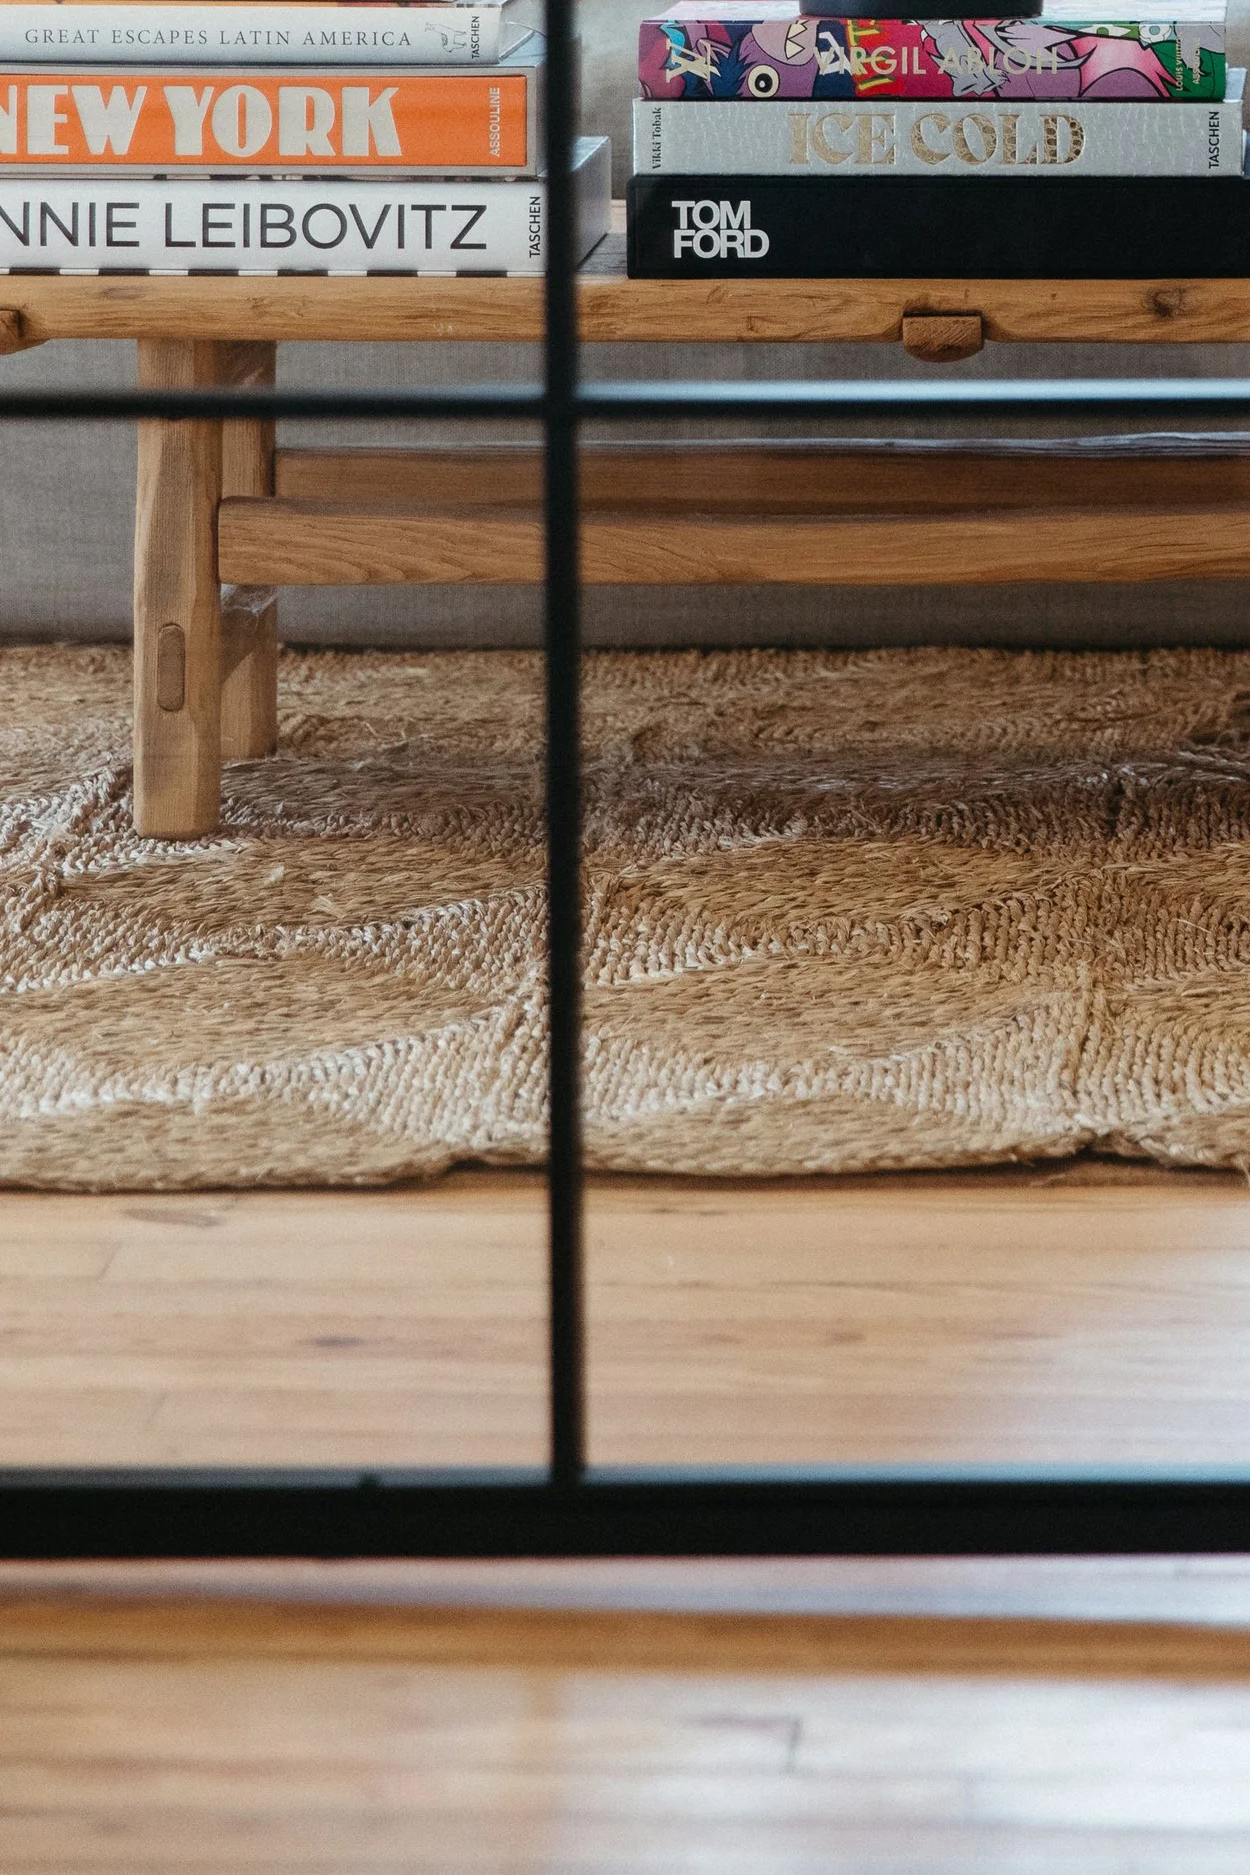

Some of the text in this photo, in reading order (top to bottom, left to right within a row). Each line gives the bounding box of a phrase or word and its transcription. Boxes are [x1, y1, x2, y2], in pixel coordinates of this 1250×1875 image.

[25, 29, 412, 46] GREAT ESCAPES LATIN AMERICA
[471, 15, 480, 59] TASCHEN
[813, 45, 1058, 76] VIRGIL ABLOH
[1175, 67, 1184, 92] LOUIS
[163, 85, 402, 158] YORK
[488, 86, 500, 157] ASSOULINE
[652, 107, 662, 170] Vikki Tobak
[787, 112, 1087, 166] ICE COLD
[1208, 111, 1220, 170] TASCHEN
[165, 202, 487, 250] LEIBOVITZ
[529, 196, 541, 259] TASCHEN
[672, 200, 751, 229] TOM
[673, 230, 769, 259] FORD
